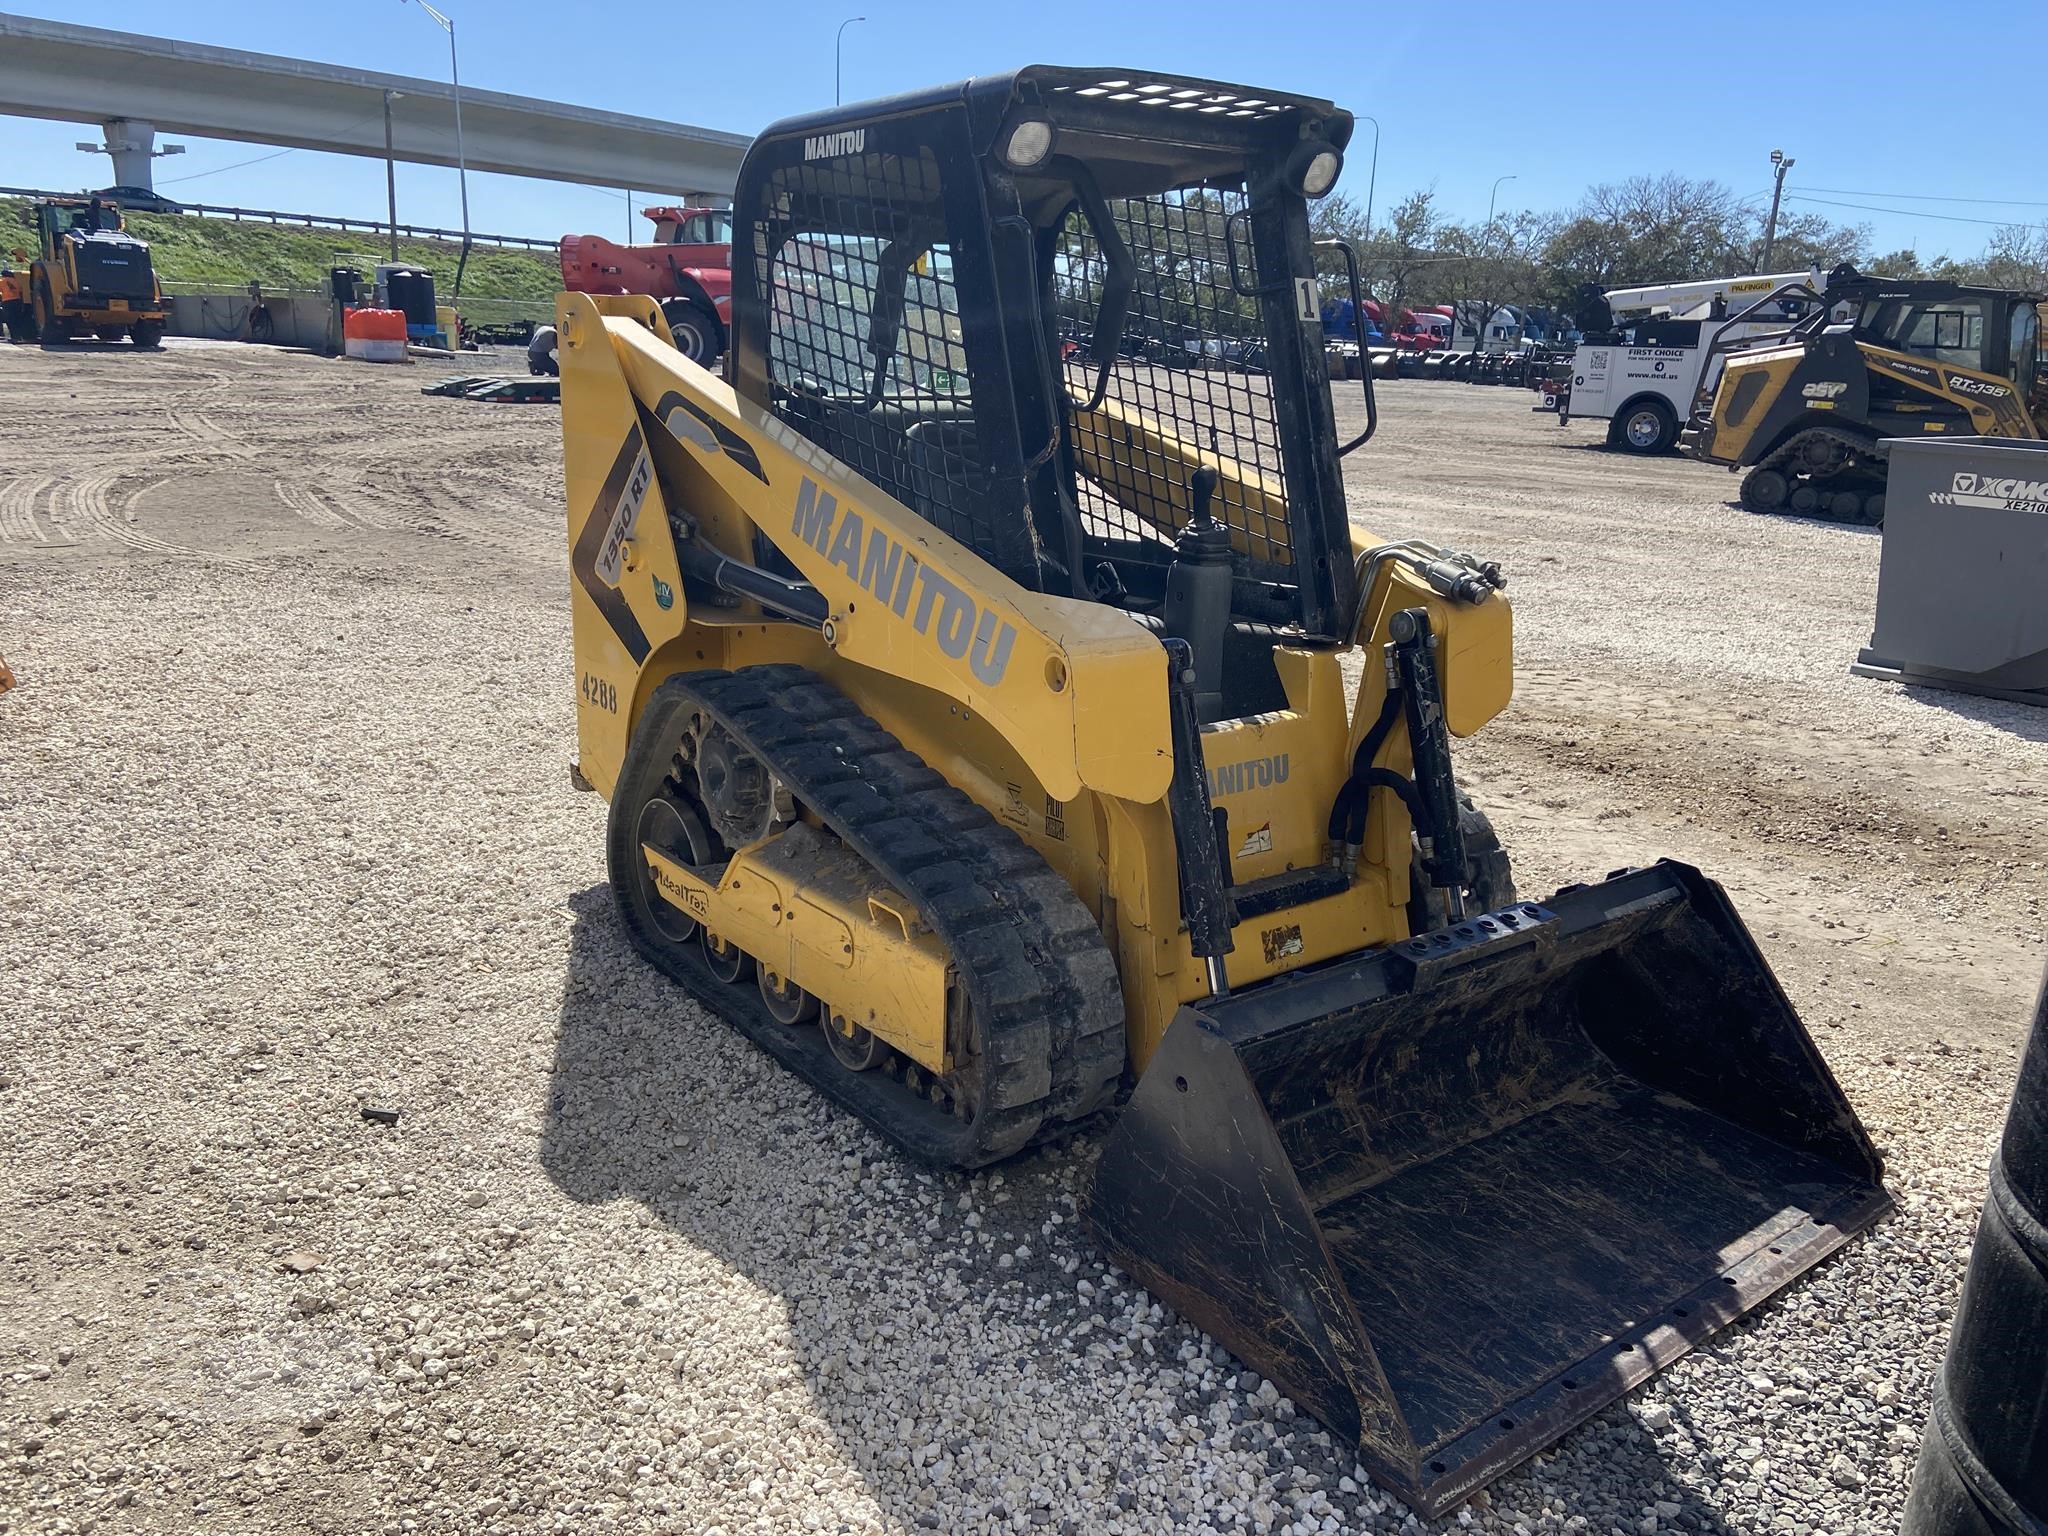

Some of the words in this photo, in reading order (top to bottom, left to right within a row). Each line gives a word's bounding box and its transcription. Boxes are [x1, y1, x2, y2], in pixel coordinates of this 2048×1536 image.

[804, 128, 865, 161] MANITOU
[1301, 281, 1315, 318] 1
[1731, 282, 1771, 293] PALFINGER
[1654, 349, 1684, 357] CHOICE
[603, 503, 632, 573] 1350
[630, 458, 649, 501] RT
[791, 475, 1018, 688] MANITOU
[582, 671, 618, 715] 4288
[1206, 753, 1289, 798] ANITOU
